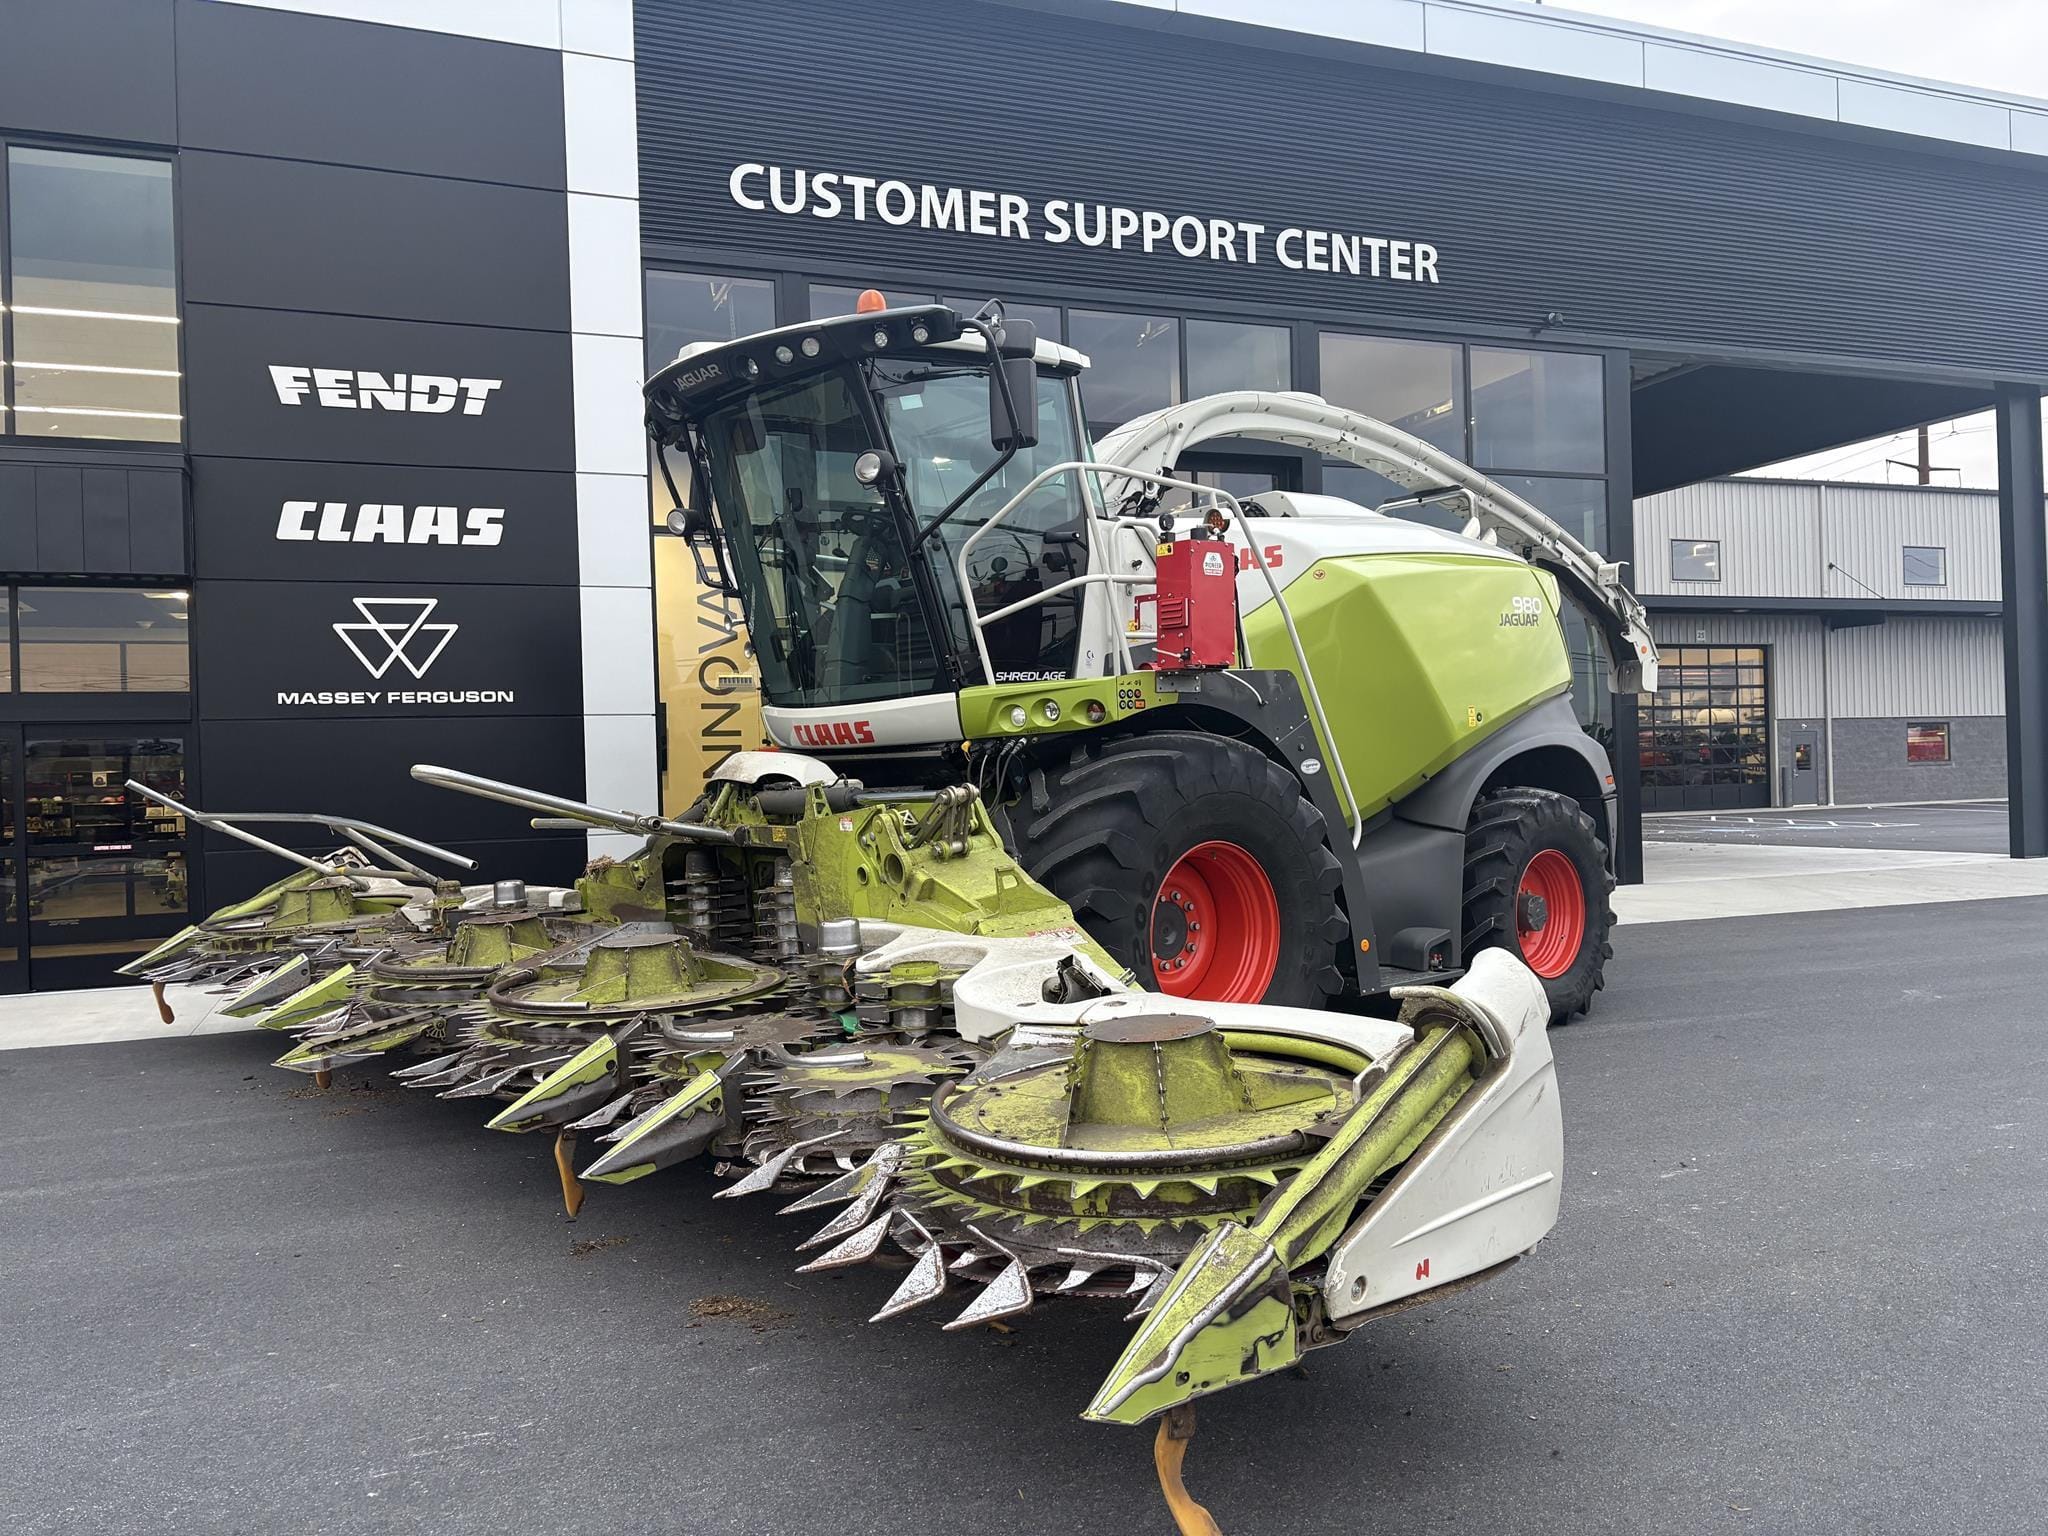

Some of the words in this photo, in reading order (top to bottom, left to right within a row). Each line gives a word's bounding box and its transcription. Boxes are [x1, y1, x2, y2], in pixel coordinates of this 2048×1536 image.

[729, 163, 1030, 239] CUSTOMER
[1043, 199, 1264, 263] SUPPORT
[1275, 228, 1440, 283] CENTER
[268, 365, 503, 415] FENDT
[673, 364, 722, 391] JAGUAR
[276, 501, 505, 546] CLAAS
[1512, 596, 1542, 614] 980
[1499, 613, 1539, 627] JAGUAR
[995, 671, 1066, 682] SHREDLAGE
[277, 691, 382, 705] MASSEY
[387, 690, 514, 704] FERGUSON
[794, 720, 875, 746] CLAAS
